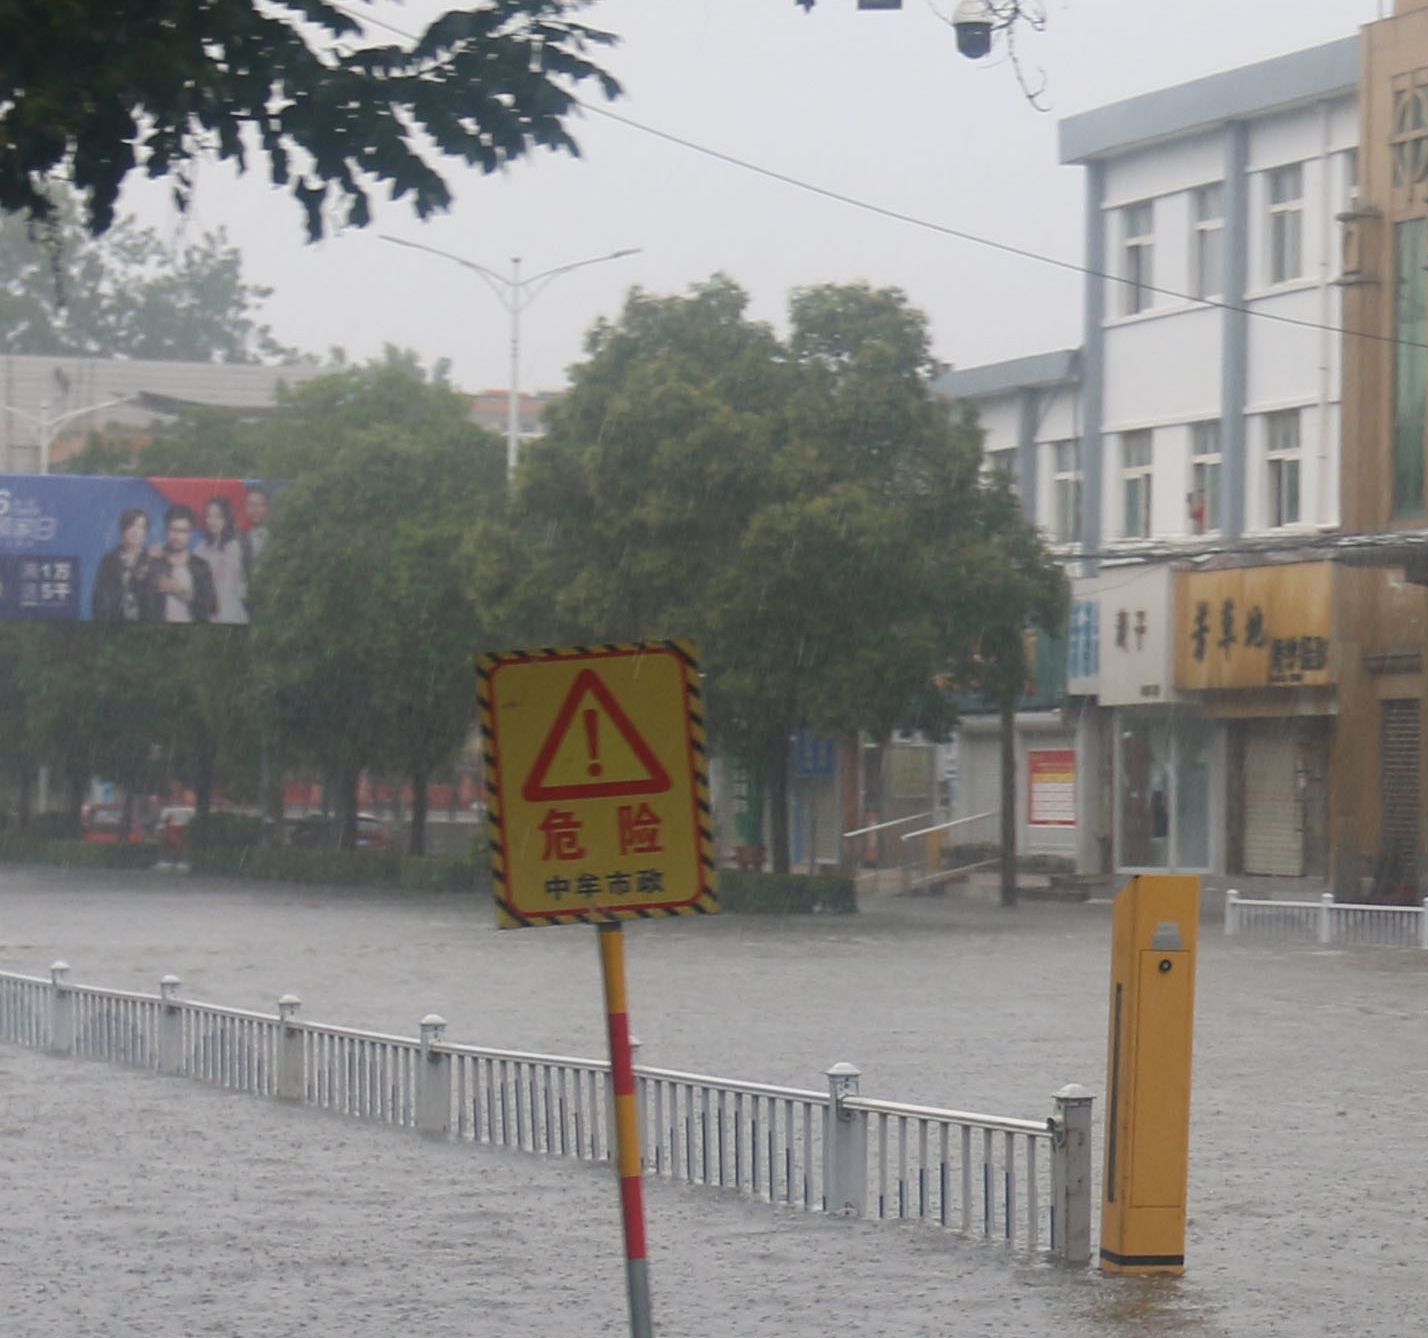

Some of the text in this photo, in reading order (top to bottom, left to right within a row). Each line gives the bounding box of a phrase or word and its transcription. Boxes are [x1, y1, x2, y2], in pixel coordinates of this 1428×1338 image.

[538, 802, 666, 862] 危险
[544, 868, 664, 900] 中牟市政
